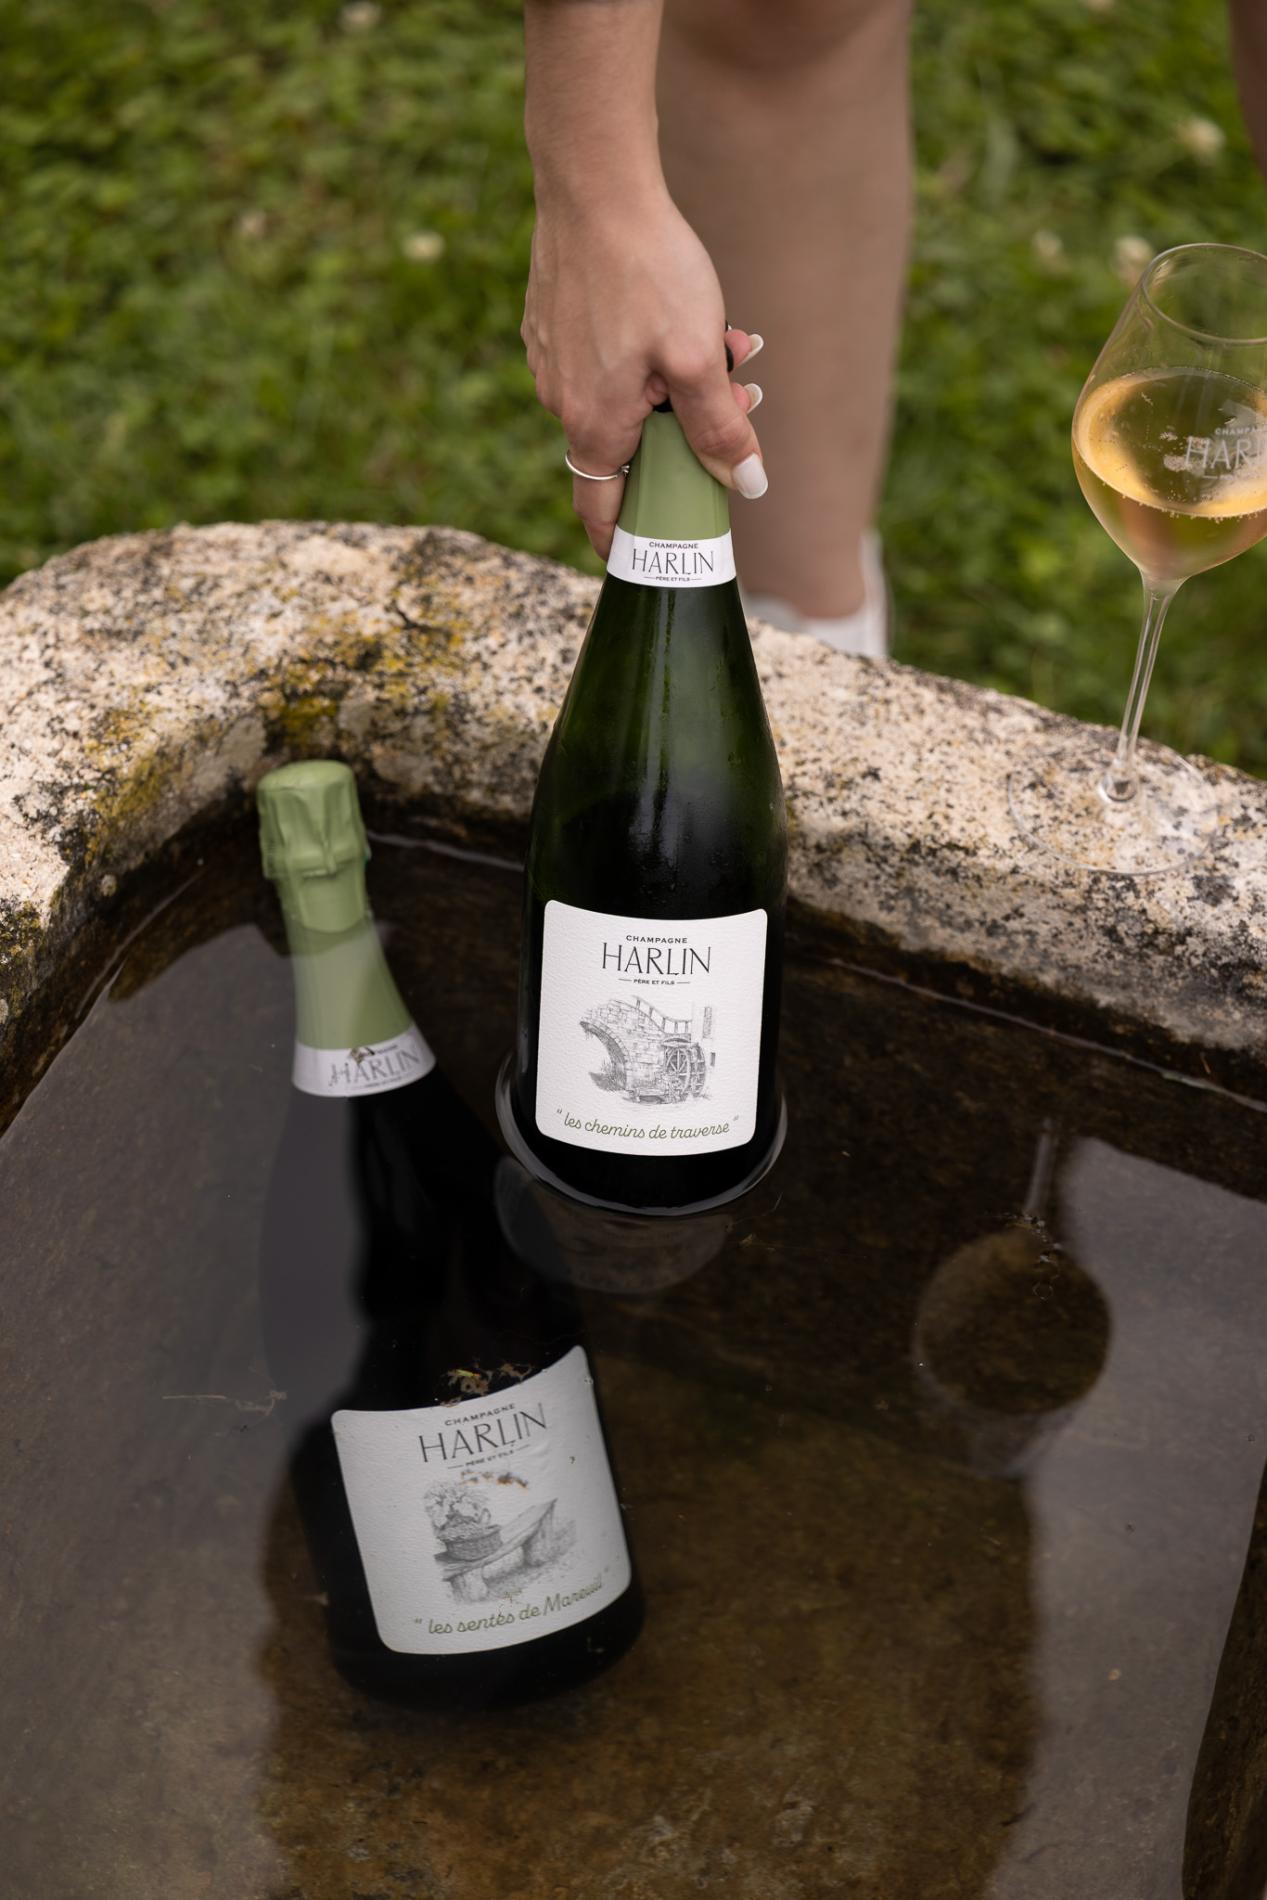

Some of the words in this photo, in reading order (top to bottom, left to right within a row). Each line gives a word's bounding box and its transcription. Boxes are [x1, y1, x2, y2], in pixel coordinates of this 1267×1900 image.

[1184, 436, 1266, 470] HAR
[649, 541, 698, 549] CHAMPAGNE
[632, 548, 714, 575] HARLIN
[626, 935, 688, 944] CHAMPAGNE
[602, 942, 711, 975] HARLIN
[331, 1049, 420, 1084] HARLIN
[564, 1112, 582, 1129] les
[585, 1119, 646, 1139] chemins
[649, 1125, 668, 1139] de
[671, 1122, 731, 1139] traverse
[444, 1403, 516, 1426] CHAMPAGNE
[419, 1402, 548, 1462] HARLIN
[428, 1618, 453, 1634] les
[519, 1603, 541, 1620] de
